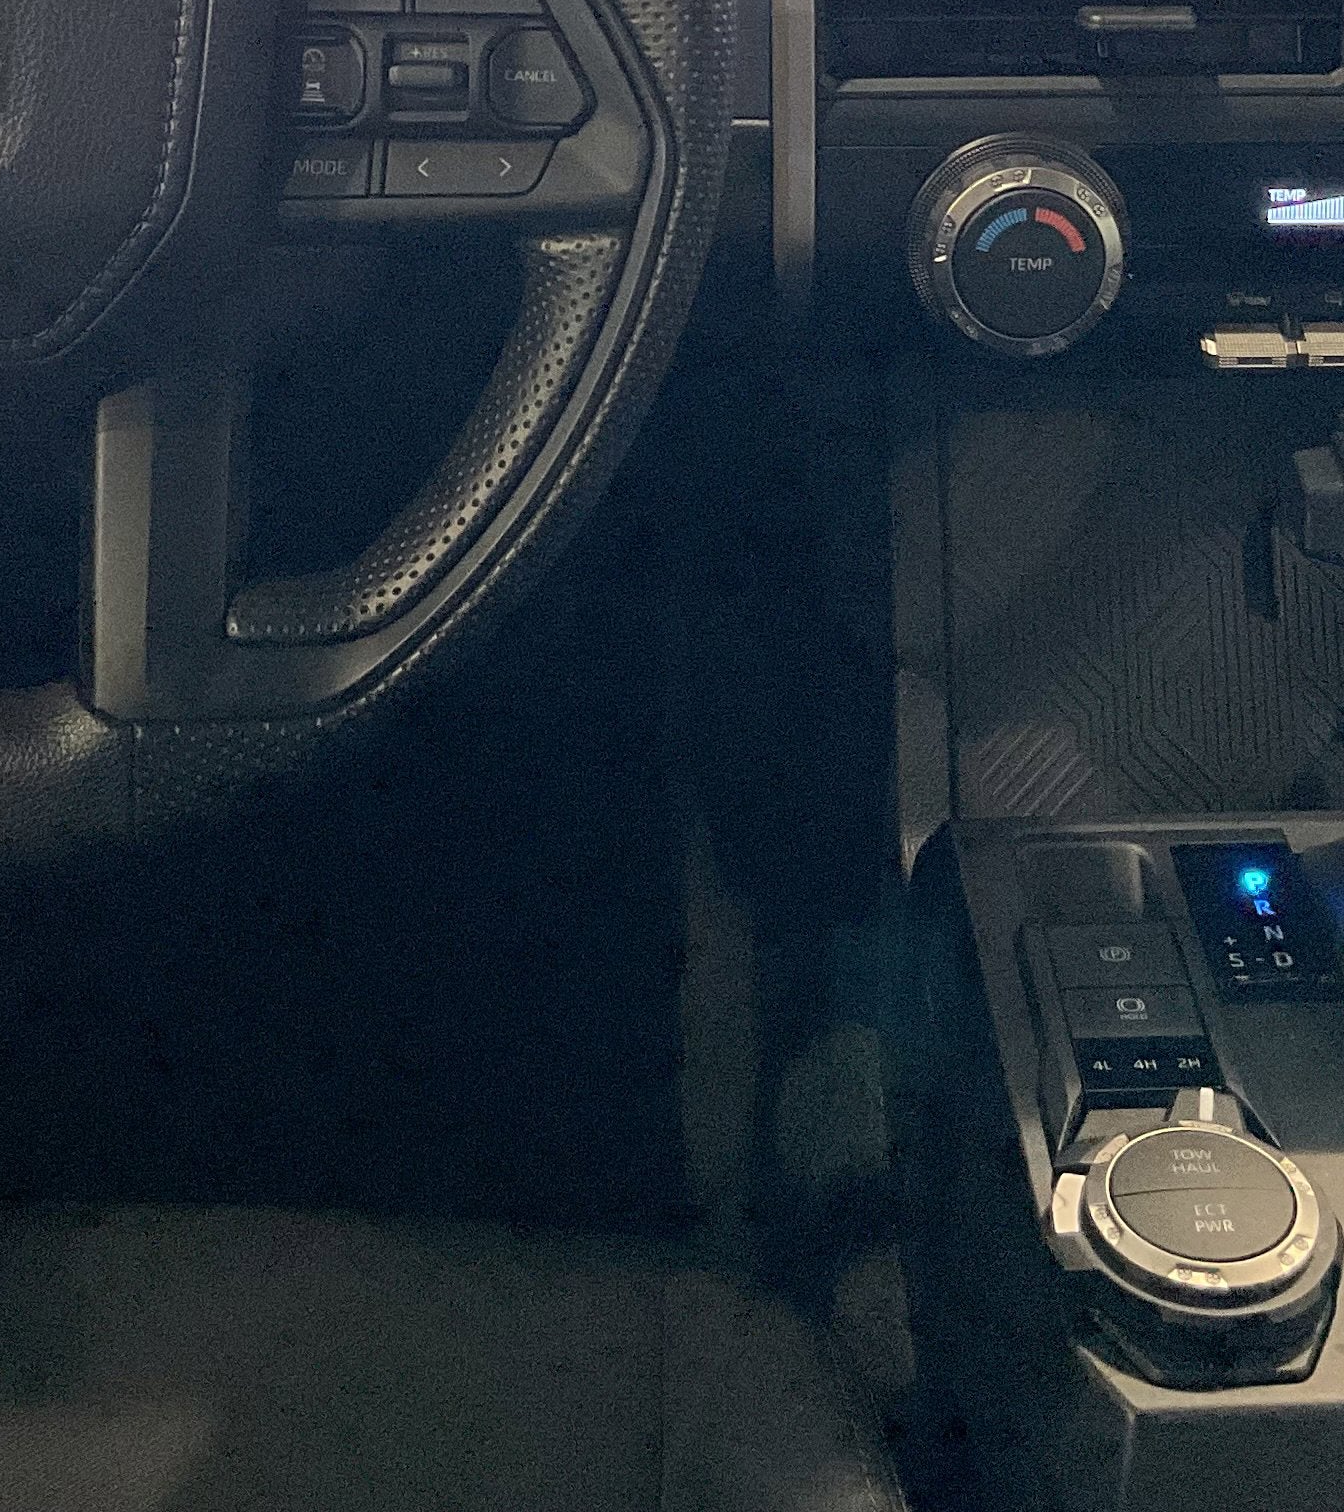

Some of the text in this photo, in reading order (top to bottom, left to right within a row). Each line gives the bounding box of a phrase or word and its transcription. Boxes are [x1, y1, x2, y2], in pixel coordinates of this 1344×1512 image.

[505, 70, 557, 82] CANCEL
[293, 159, 349, 176] MODE
[1269, 189, 1306, 202] TEMP
[1009, 257, 1052, 271] TEMP
[1243, 869, 1267, 892] P
[1254, 900, 1276, 915] R
[1264, 925, 1284, 940] N
[1228, 951, 1293, 968] S D
[1093, 1057, 1201, 1071] 4L 4H 2H
[1172, 1149, 1212, 1160] TOW
[1171, 1162, 1221, 1174] HAUL
[1194, 1203, 1226, 1217] ECT
[1195, 1219, 1235, 1233] PWR
